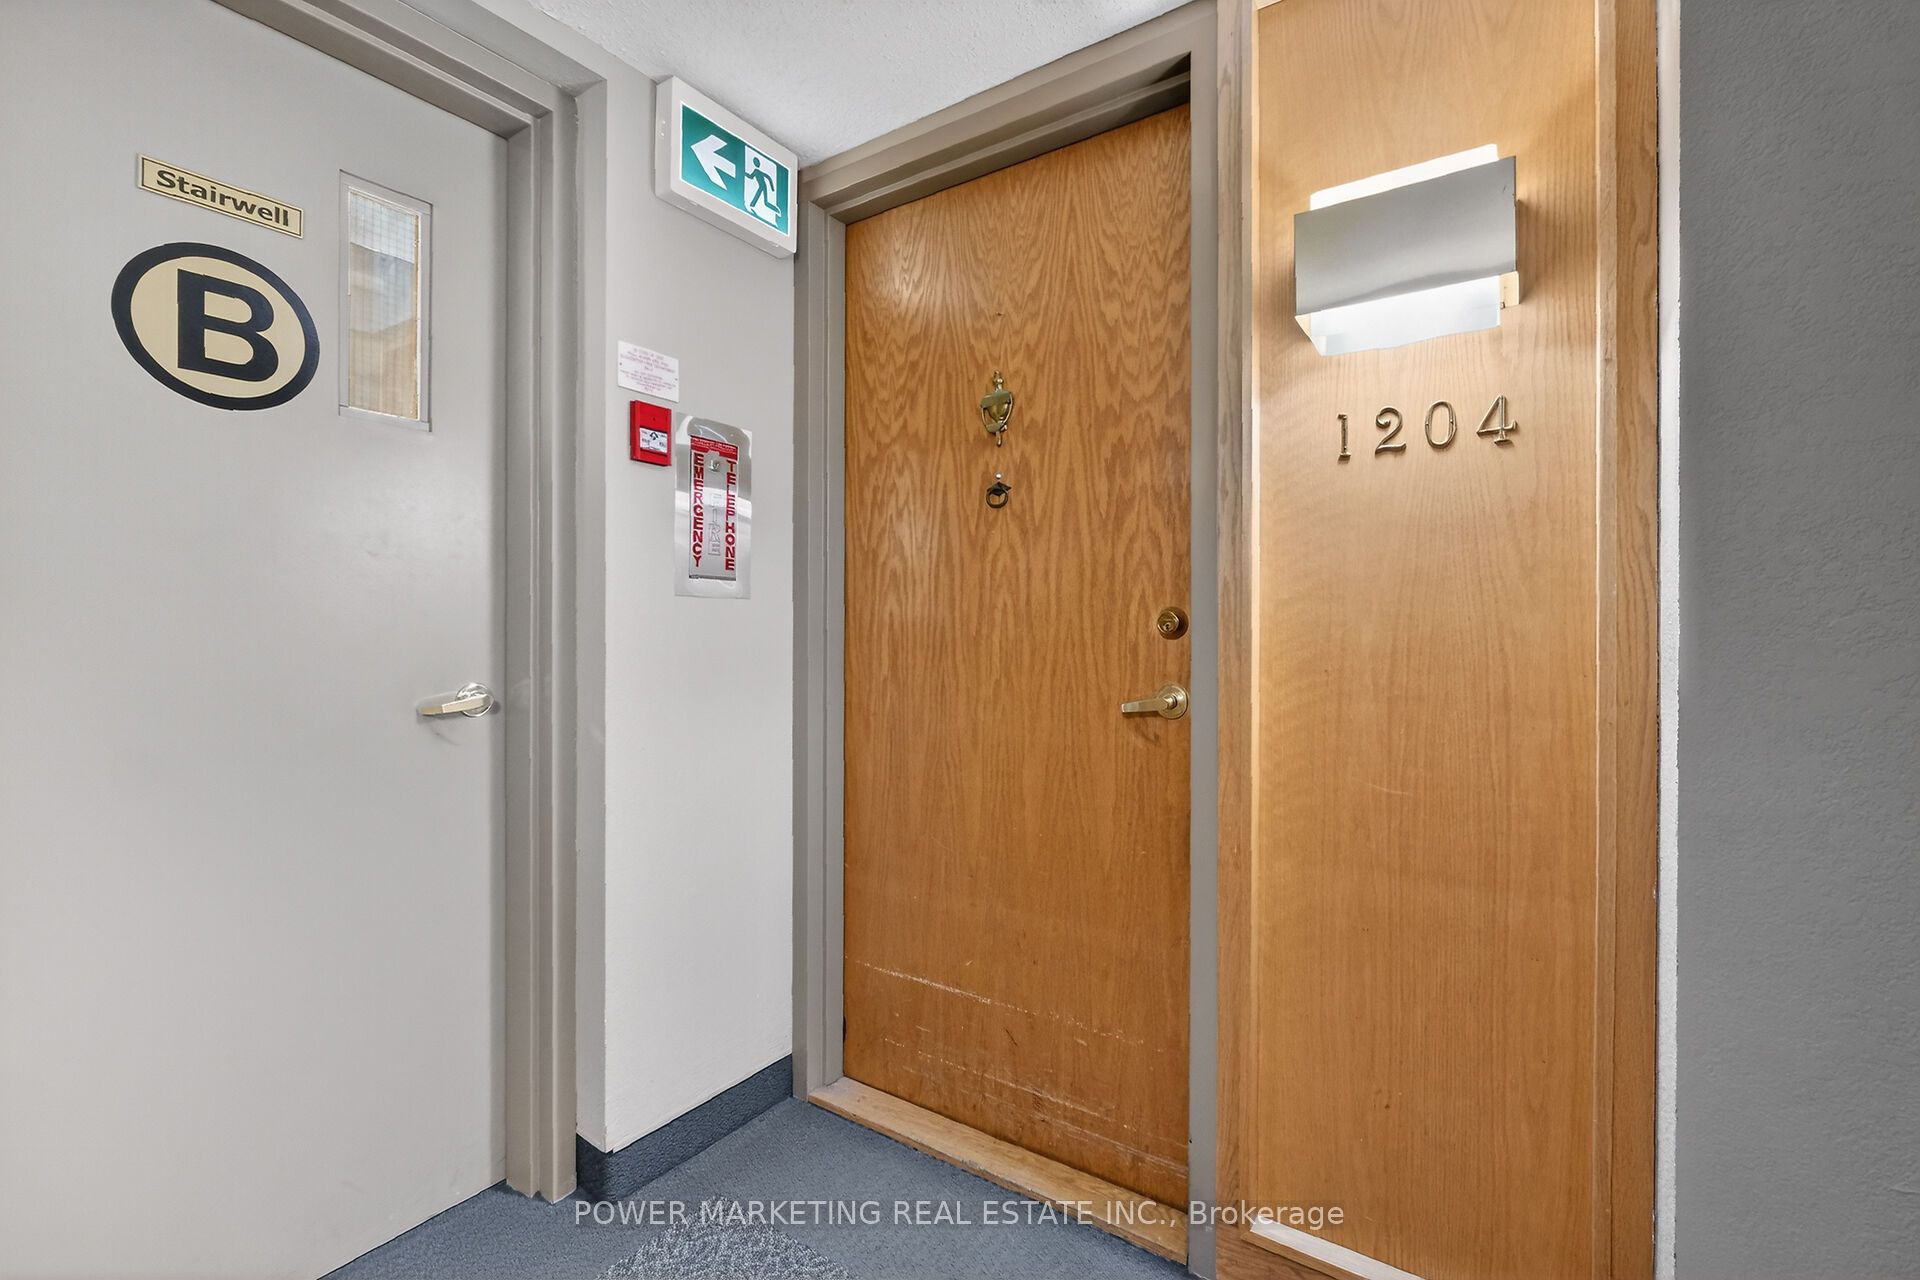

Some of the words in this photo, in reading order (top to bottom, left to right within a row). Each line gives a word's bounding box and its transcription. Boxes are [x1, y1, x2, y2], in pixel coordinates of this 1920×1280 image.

[156, 169, 289, 227] Stairwell
[177, 268, 279, 383] B
[1337, 394, 1518, 460] 1204
[692, 452, 705, 568] EMERGENCY
[725, 459, 738, 572] TELEPHONE
